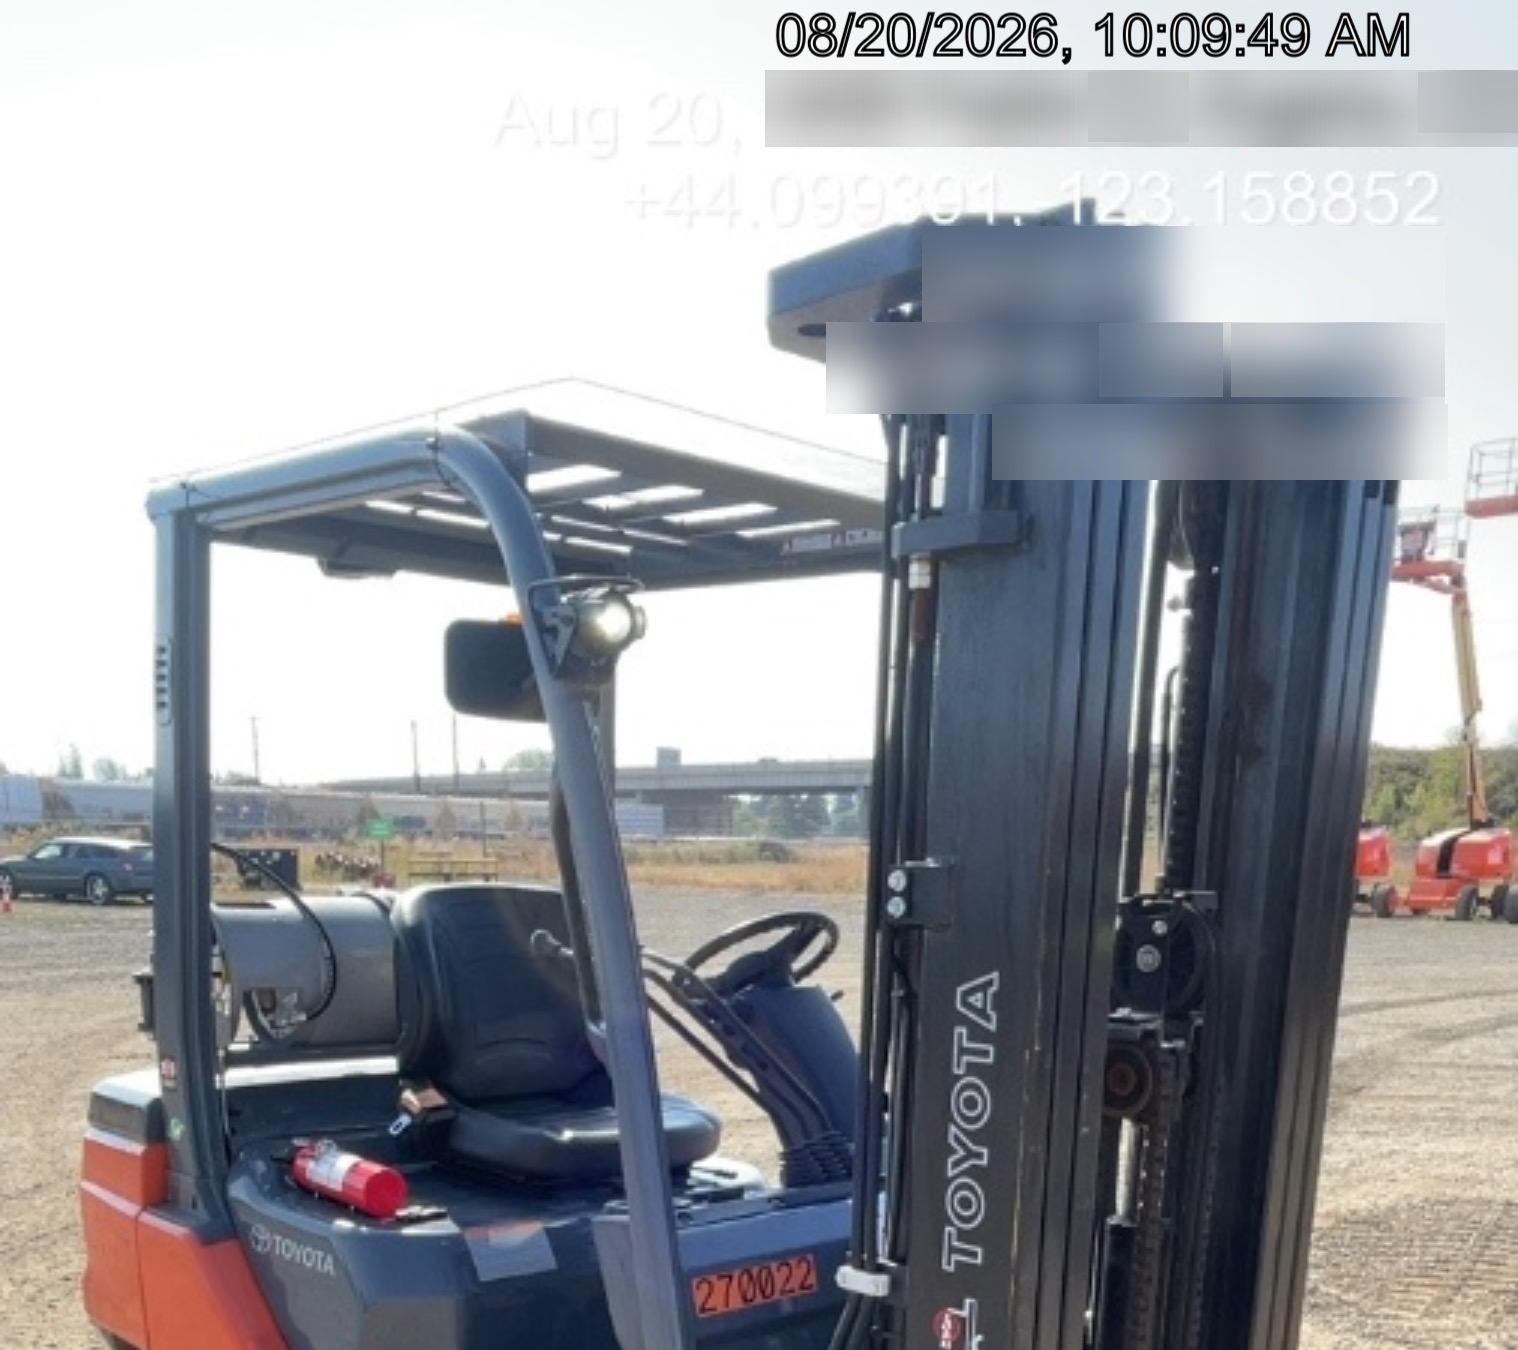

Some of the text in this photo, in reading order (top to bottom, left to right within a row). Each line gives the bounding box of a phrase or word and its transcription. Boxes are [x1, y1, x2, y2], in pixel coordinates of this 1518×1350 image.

[942, 971, 1000, 1271] TOYOTA
[273, 1234, 335, 1276] TOYOTA
[695, 1255, 813, 1314] 270022
